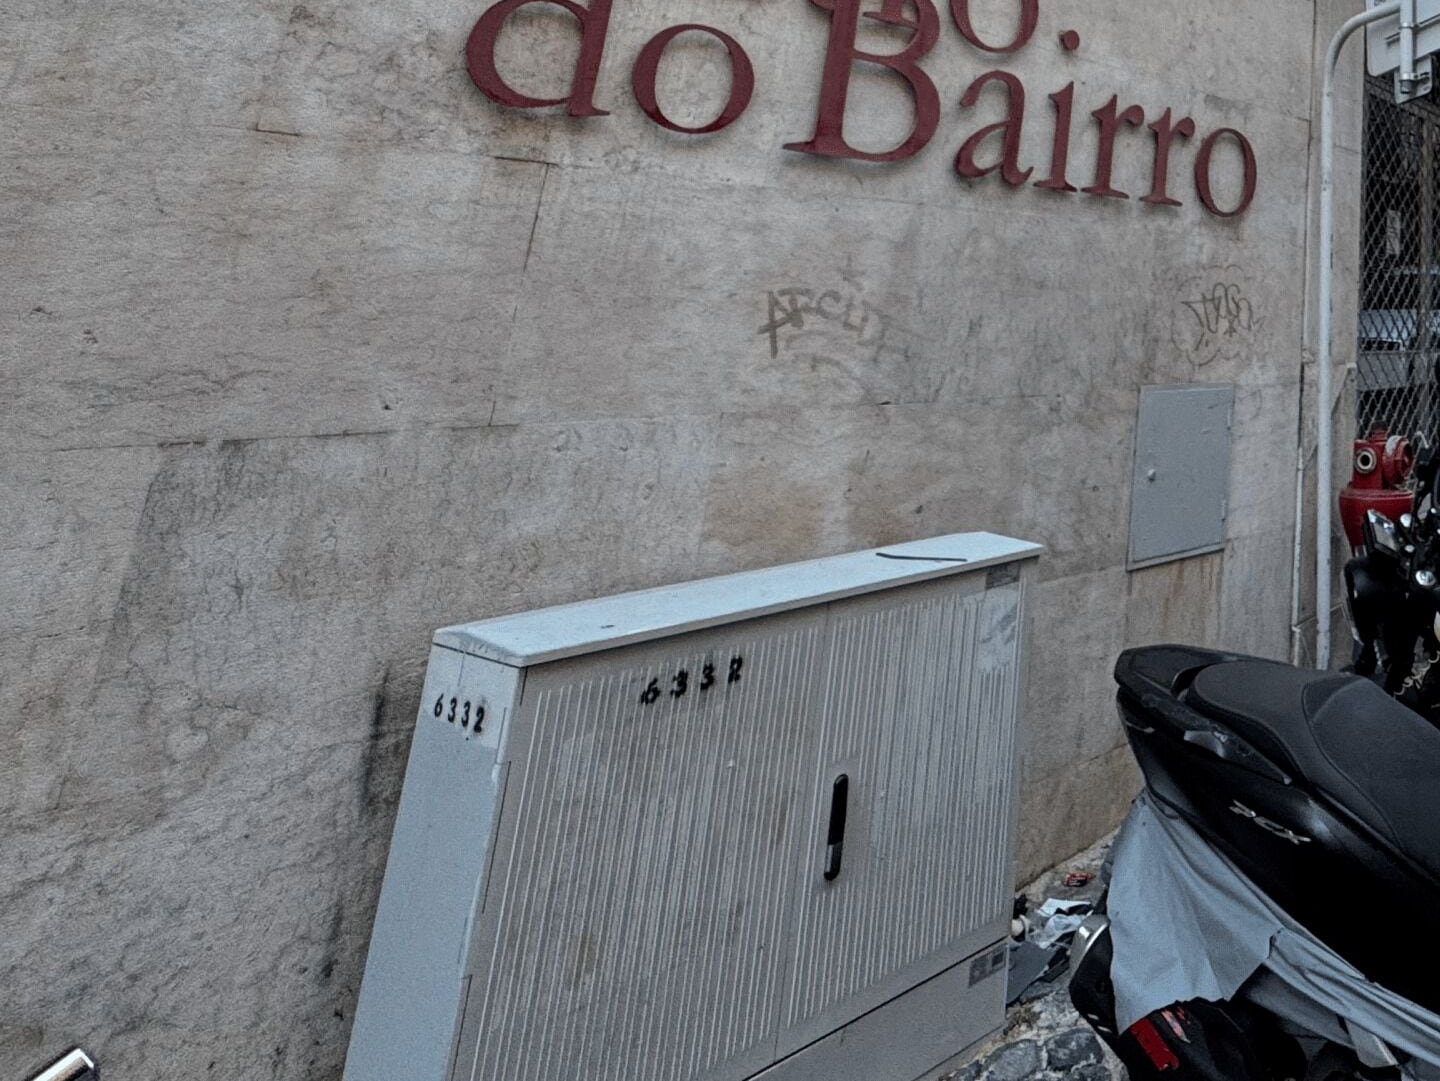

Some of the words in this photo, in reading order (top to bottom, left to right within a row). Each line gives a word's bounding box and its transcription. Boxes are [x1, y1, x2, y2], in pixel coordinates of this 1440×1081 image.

[641, 656, 743, 705] 6332
[434, 693, 485, 733] 6332
[1228, 800, 1312, 845] PCX
